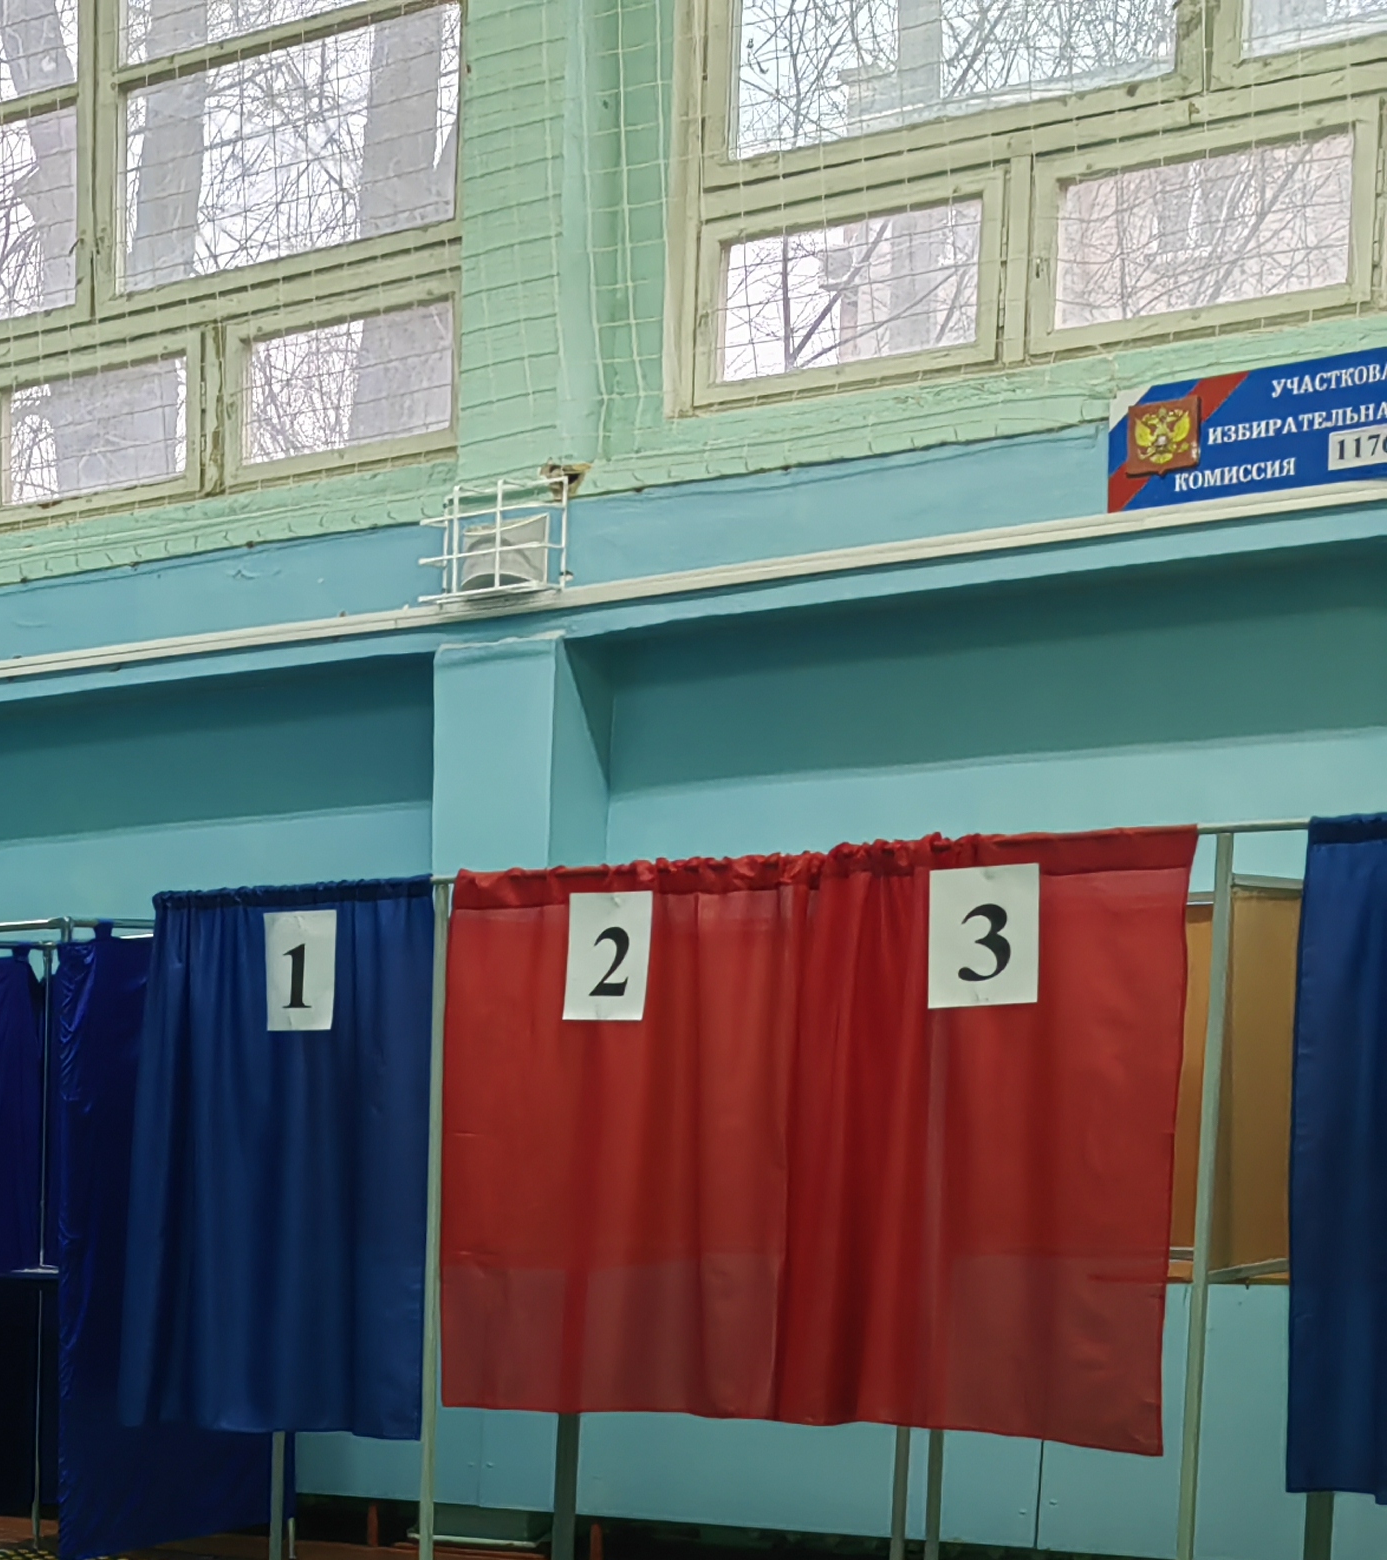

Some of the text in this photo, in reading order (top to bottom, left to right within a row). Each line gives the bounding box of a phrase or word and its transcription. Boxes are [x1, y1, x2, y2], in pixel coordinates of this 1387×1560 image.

[1174, 457, 1296, 492] КОМИССИЯ
[282, 943, 312, 1009] 1
[588, 926, 630, 997] 2
[958, 903, 1012, 982] 3
